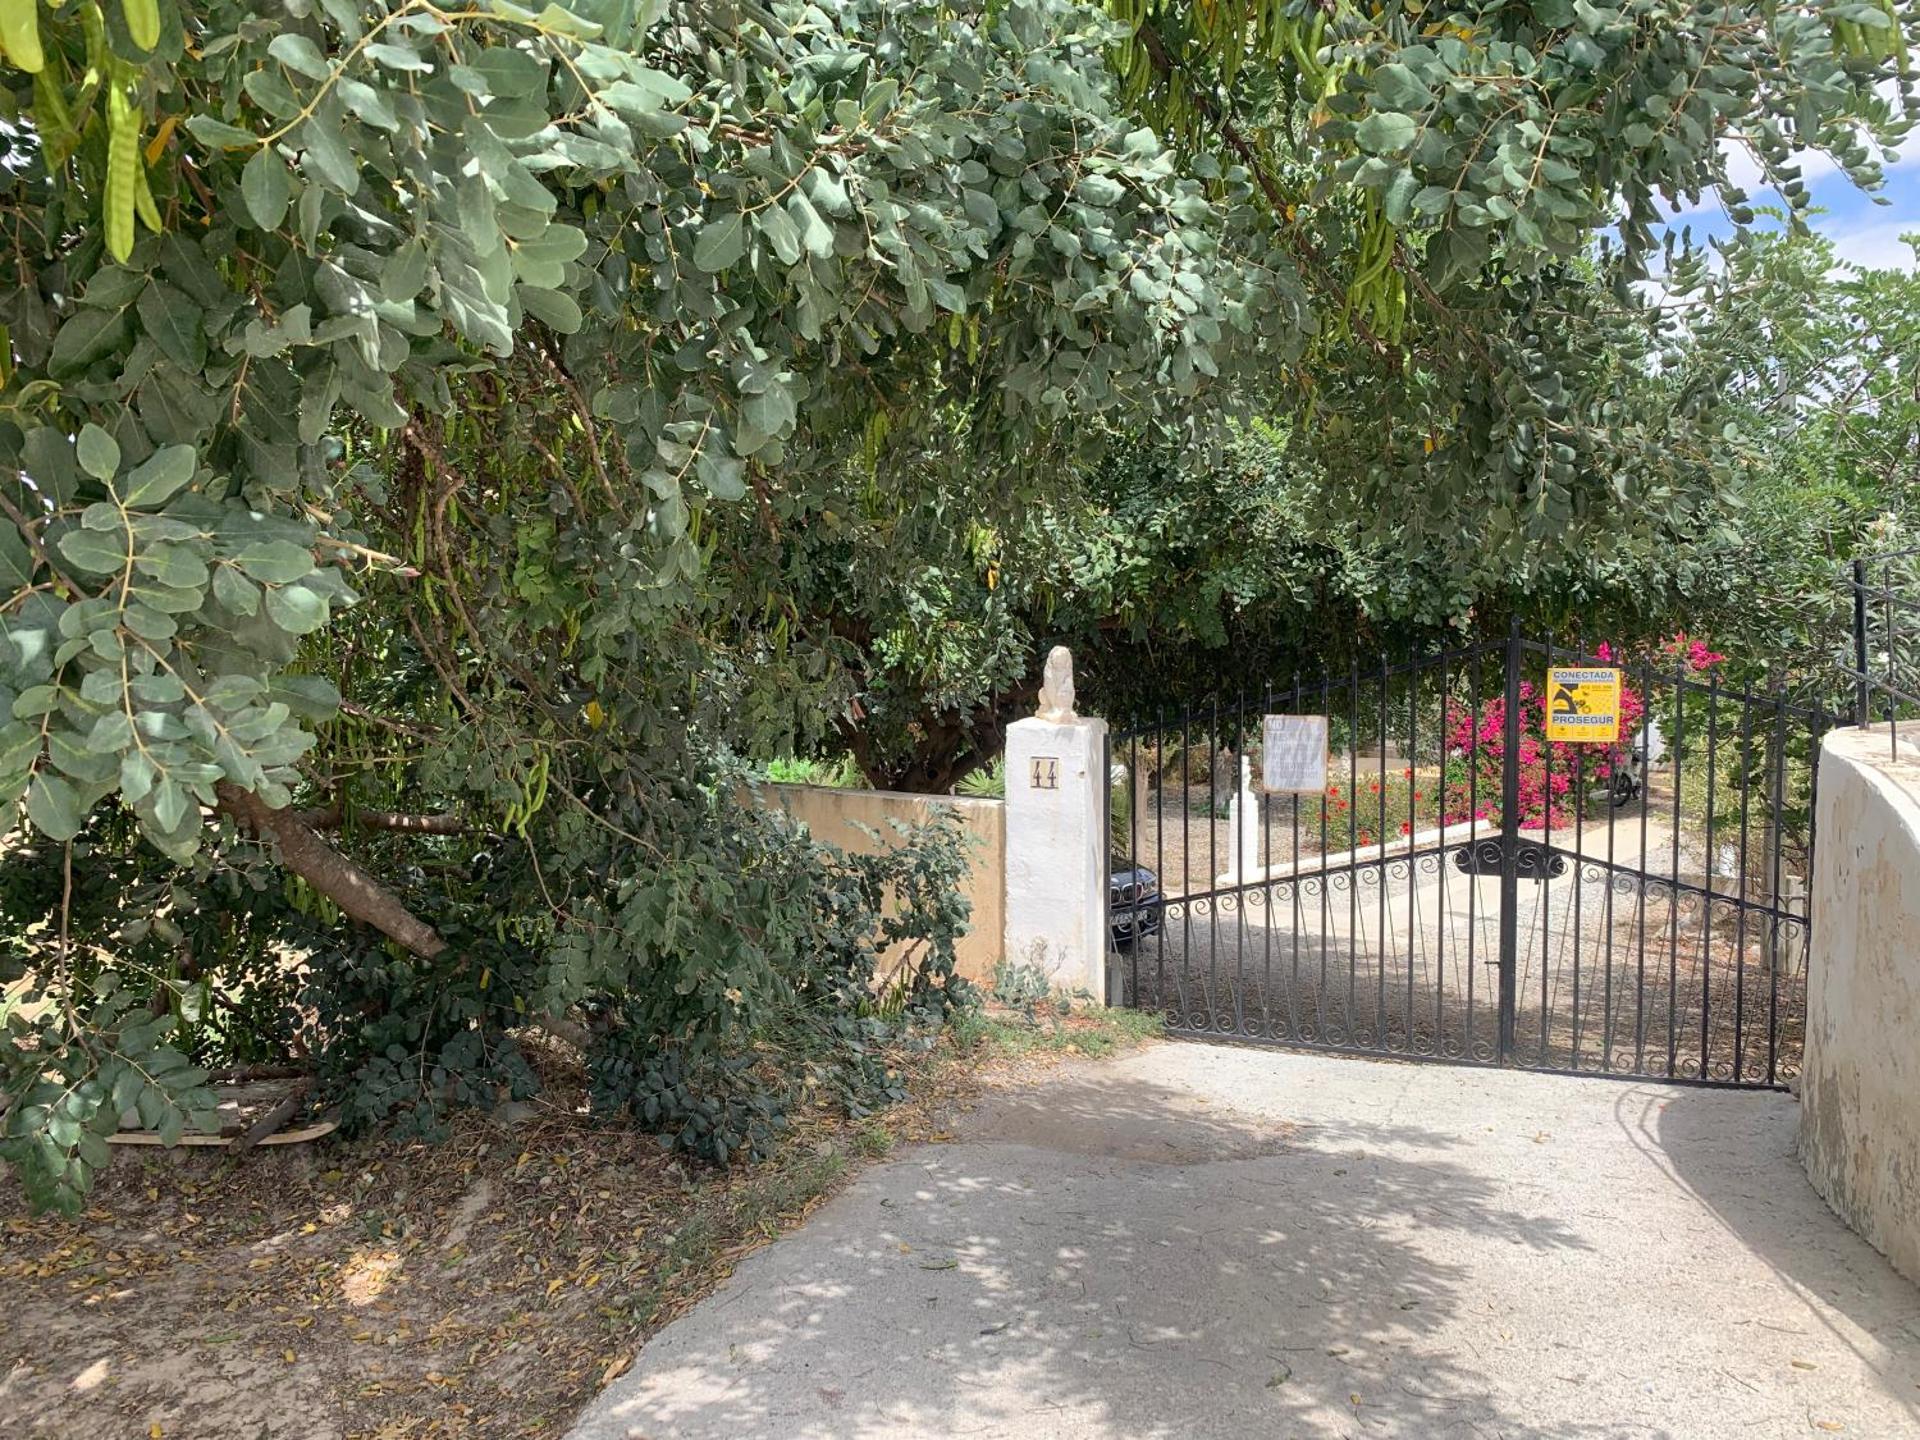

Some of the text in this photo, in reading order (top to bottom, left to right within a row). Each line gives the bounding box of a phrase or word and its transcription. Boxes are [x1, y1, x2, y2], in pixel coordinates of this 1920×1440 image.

[1553, 671, 1614, 679] CONECTADA
[1552, 716, 1614, 724] PROSEGUR
[1033, 760, 1057, 787] 44
